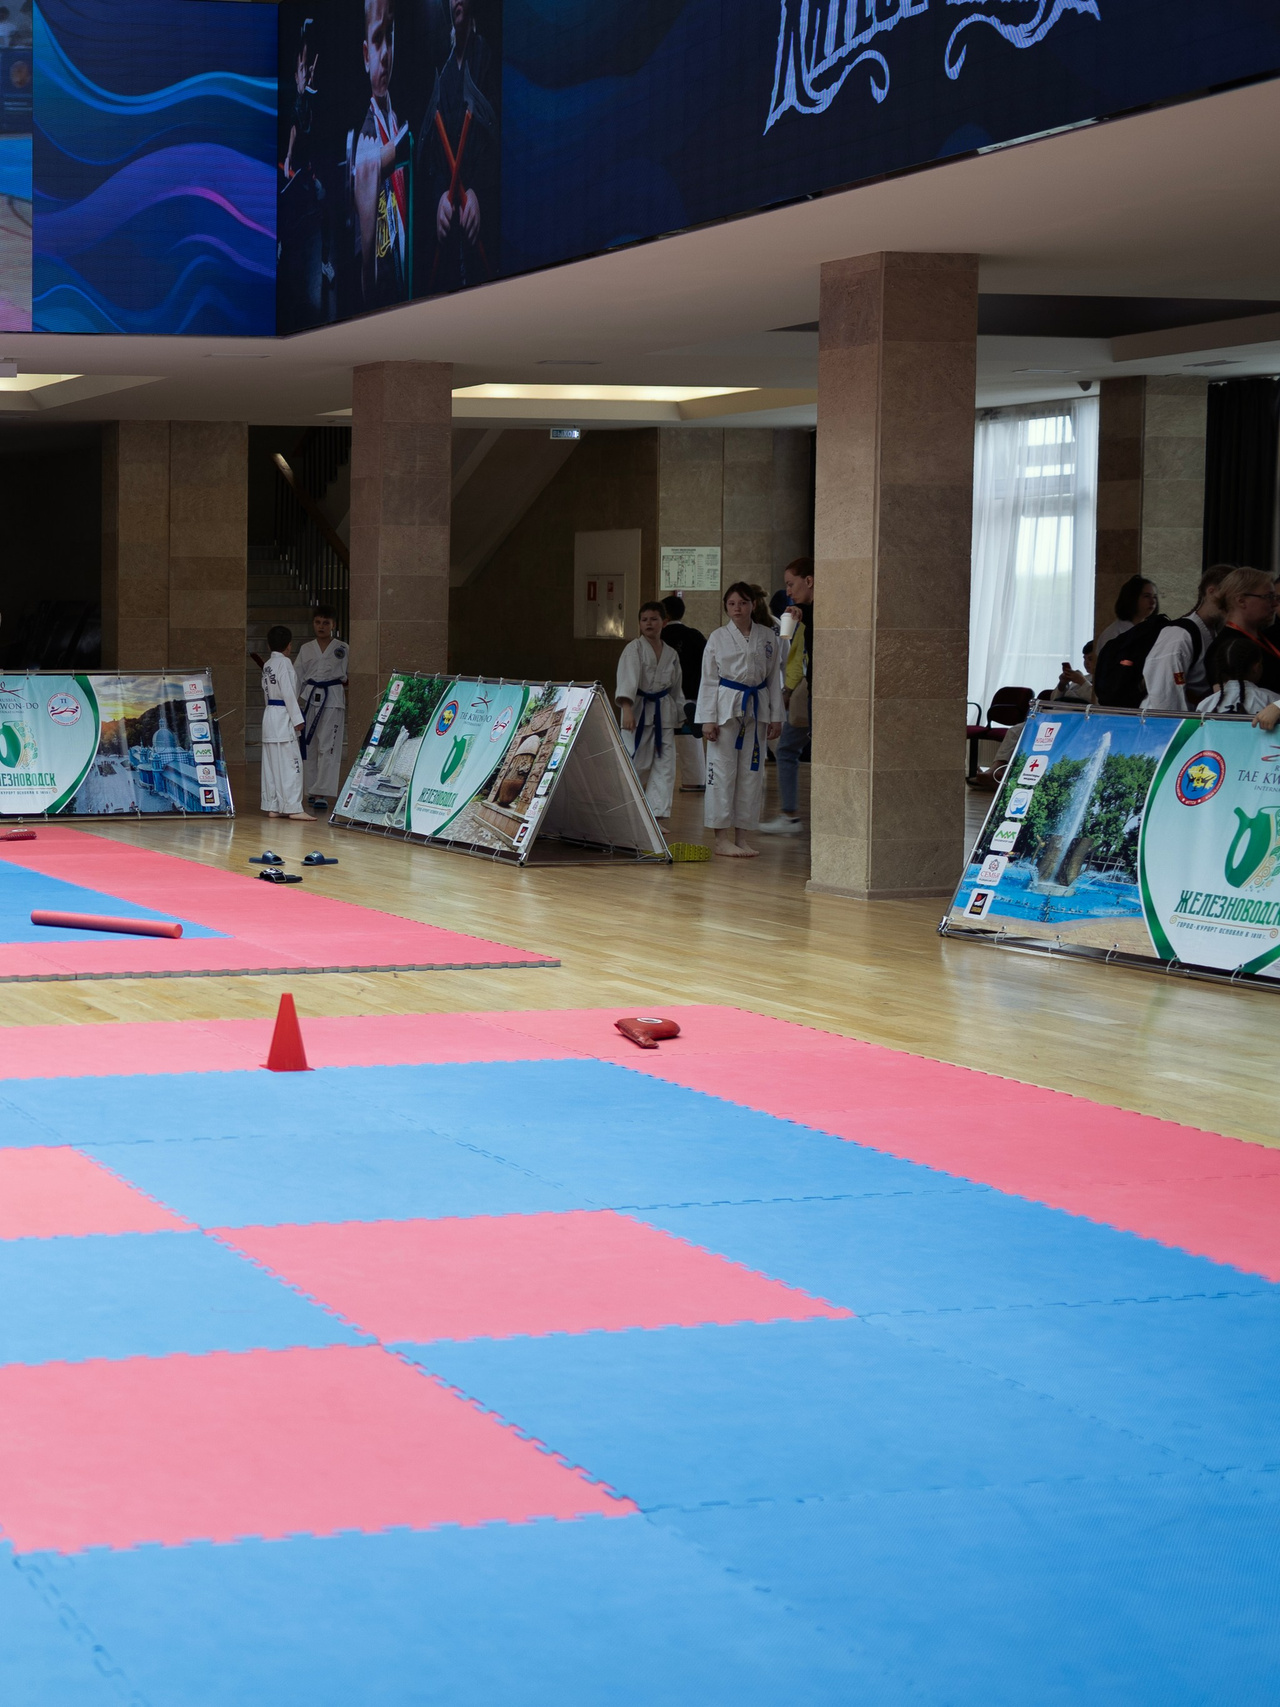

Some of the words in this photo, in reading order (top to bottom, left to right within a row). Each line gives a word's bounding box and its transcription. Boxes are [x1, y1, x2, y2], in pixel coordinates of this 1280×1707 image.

[1238, 769, 1259, 782] TAE
[1176, 921, 1218, 933] ГОРОД-КУРОРТ
[1219, 927, 1243, 937] ОСНОВАН
